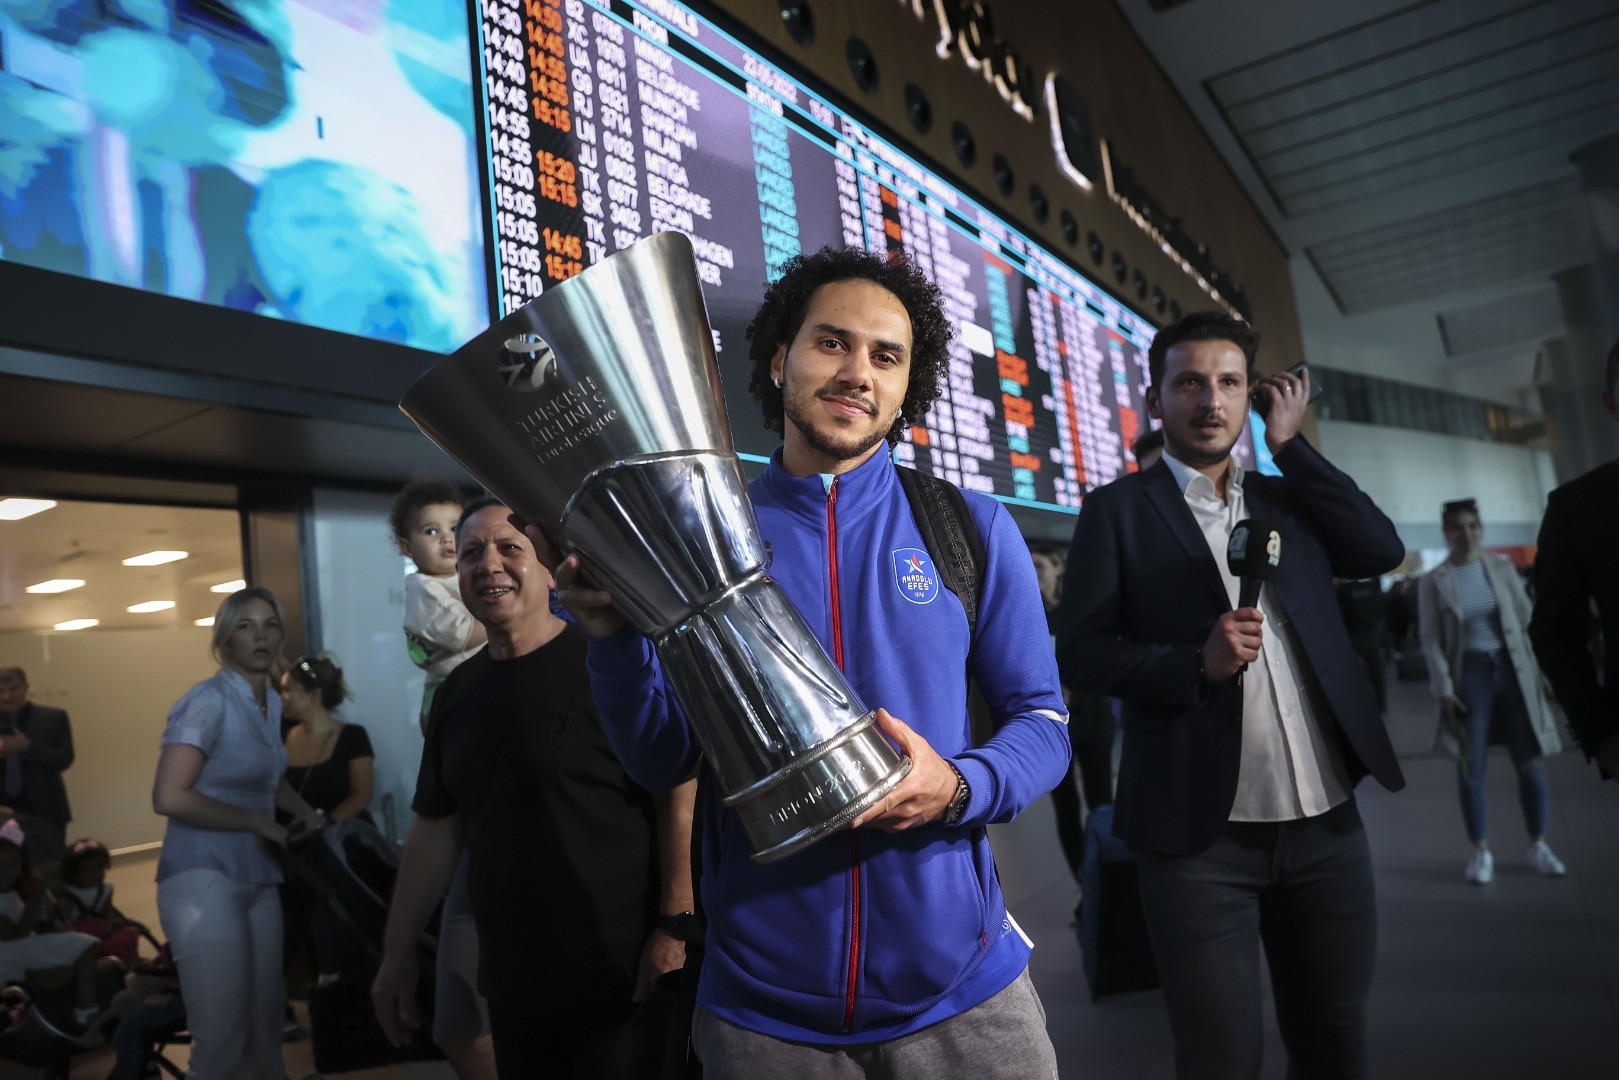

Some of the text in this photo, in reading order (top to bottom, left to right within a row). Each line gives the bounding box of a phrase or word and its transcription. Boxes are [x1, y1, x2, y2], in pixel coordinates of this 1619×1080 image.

[526, 20, 565, 58] 14:45
[569, 42, 592, 74] UA
[638, 81, 688, 125] MUNICH
[634, 35, 675, 77] MINSK
[636, 58, 702, 112] BELGRADE
[483, 22, 525, 61] 14:40
[528, 46, 567, 83] 14:55
[641, 104, 698, 150] SHARJAH
[484, 47, 526, 86] 14:40
[530, 70, 569, 107] 14:55
[573, 90, 594, 119] RJ
[642, 126, 682, 162] MILAN
[486, 74, 528, 112] 14:45
[532, 97, 571, 132] 15:15
[488, 102, 531, 139] 14:55
[577, 143, 598, 169] JU
[647, 172, 713, 220] BELGRADE
[490, 129, 533, 165] 14:55
[536, 149, 576, 184] 15:20
[579, 166, 603, 195] TK
[649, 196, 695, 234] ERCAN
[492, 154, 534, 191] 15:00
[538, 174, 578, 208] 15:15
[582, 190, 605, 219] SK
[494, 183, 537, 219] 15:05
[583, 215, 607, 245] TK
[497, 210, 539, 246] 15:05
[542, 227, 583, 261] 14:45
[499, 239, 542, 274] 15:05
[501, 266, 543, 299] 15:10
[902, 574, 933, 585] ANADOLU
[907, 582, 930, 591] EFES
